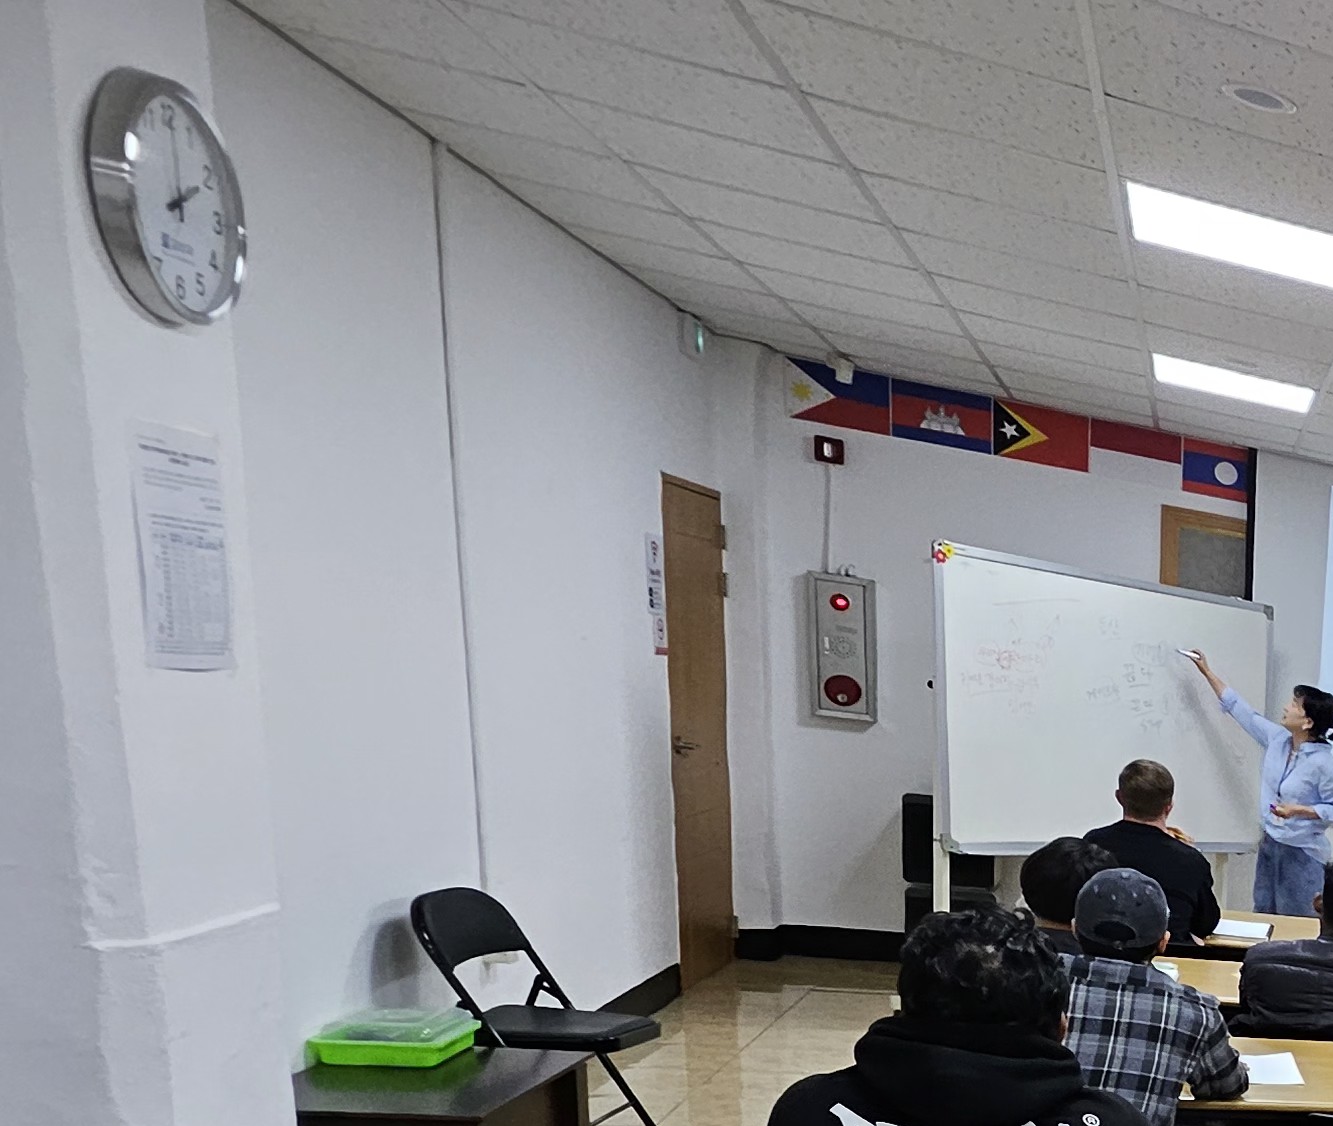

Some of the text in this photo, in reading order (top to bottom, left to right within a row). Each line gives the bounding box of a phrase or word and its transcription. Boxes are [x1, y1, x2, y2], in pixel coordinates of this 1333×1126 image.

[203, 165, 213, 190] 2
[213, 211, 222, 235] 3
[209, 250, 219, 270] 4
[176, 275, 185, 300] 6
[195, 272, 205, 296] 5
